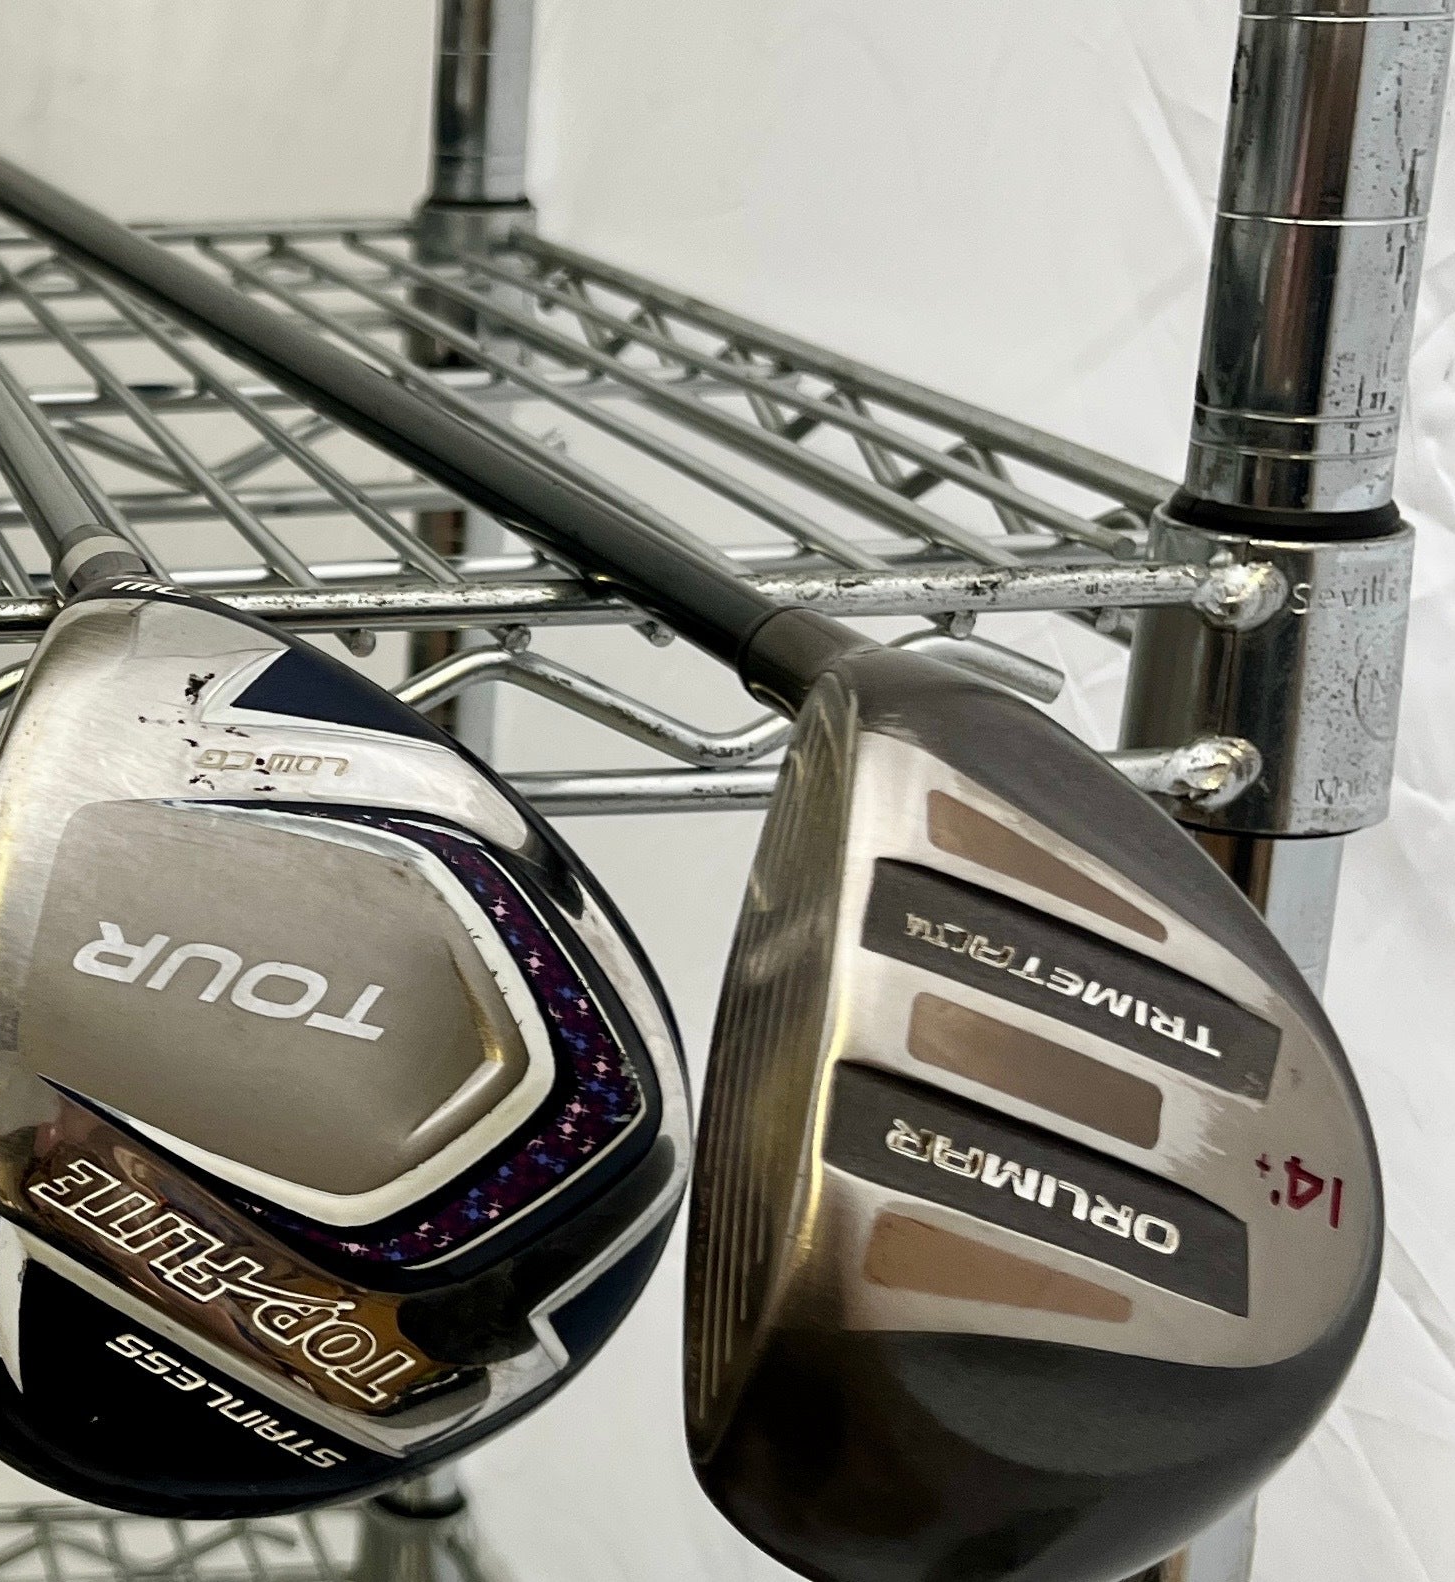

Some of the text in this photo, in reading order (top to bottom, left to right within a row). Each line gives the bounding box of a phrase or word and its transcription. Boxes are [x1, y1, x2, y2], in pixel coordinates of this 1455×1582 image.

[72, 920, 386, 1043] TOUR
[884, 1117, 1182, 1256] ORLIMAR
[105, 1333, 348, 1469] STAINLESS
